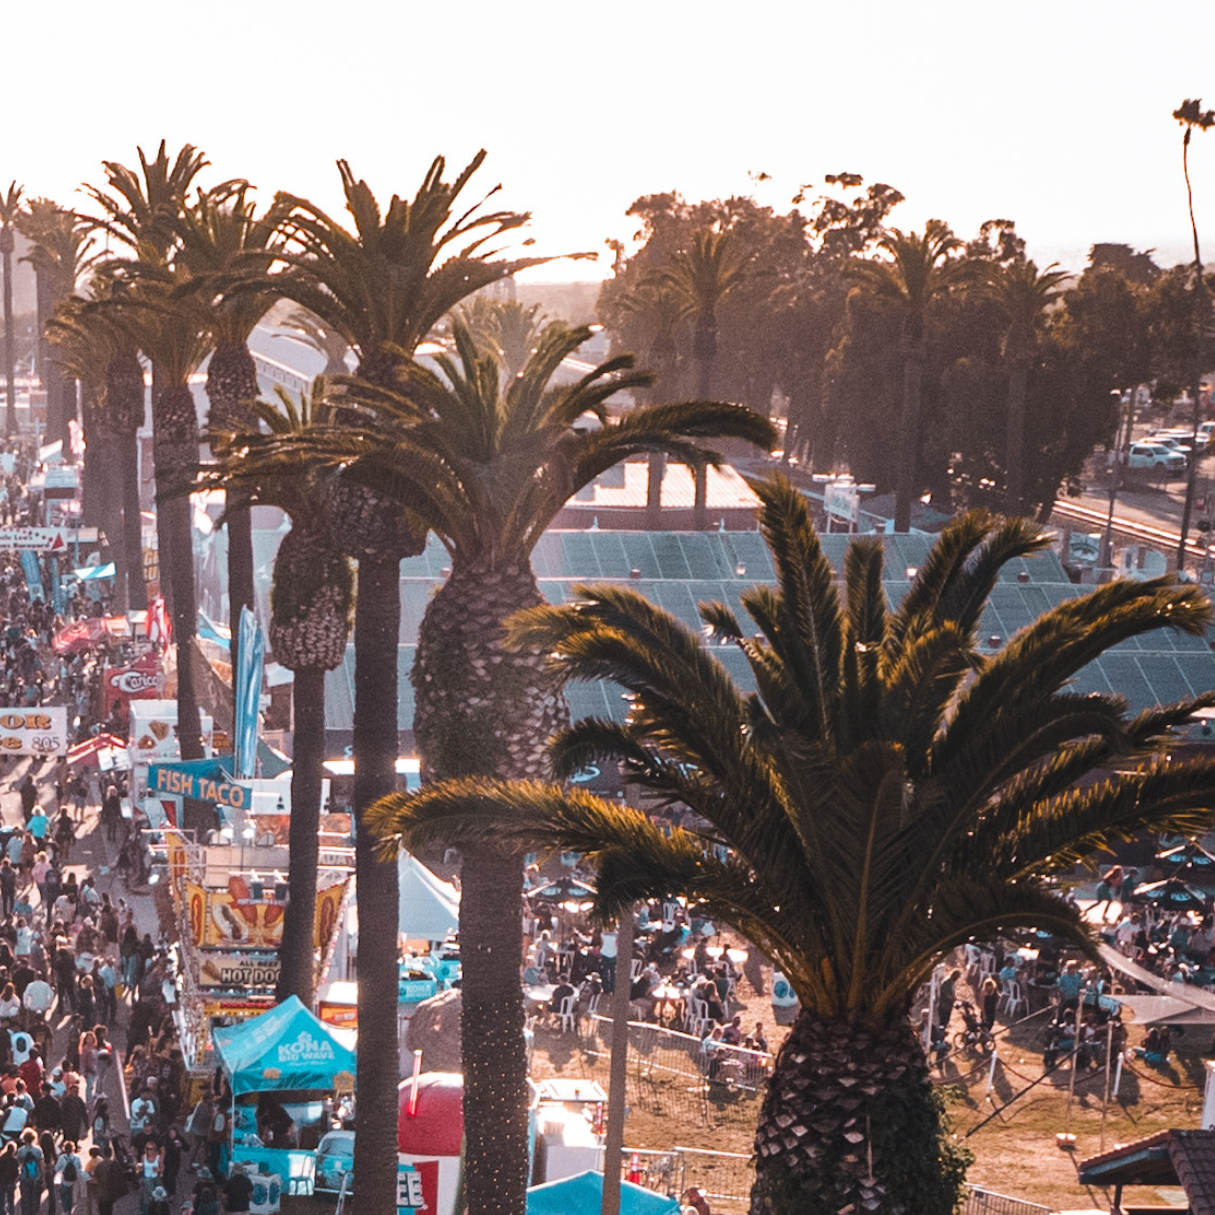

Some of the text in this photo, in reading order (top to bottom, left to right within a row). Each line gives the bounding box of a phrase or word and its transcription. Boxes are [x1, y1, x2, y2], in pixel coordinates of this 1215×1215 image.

[31, 736, 61, 750] 805
[157, 769, 245, 807] FISH TACO
[220, 968, 252, 984] HOT
[278, 1040, 333, 1055] KONA
[278, 1052, 335, 1062] BIG WAVE
[397, 1171, 424, 1206] EE
